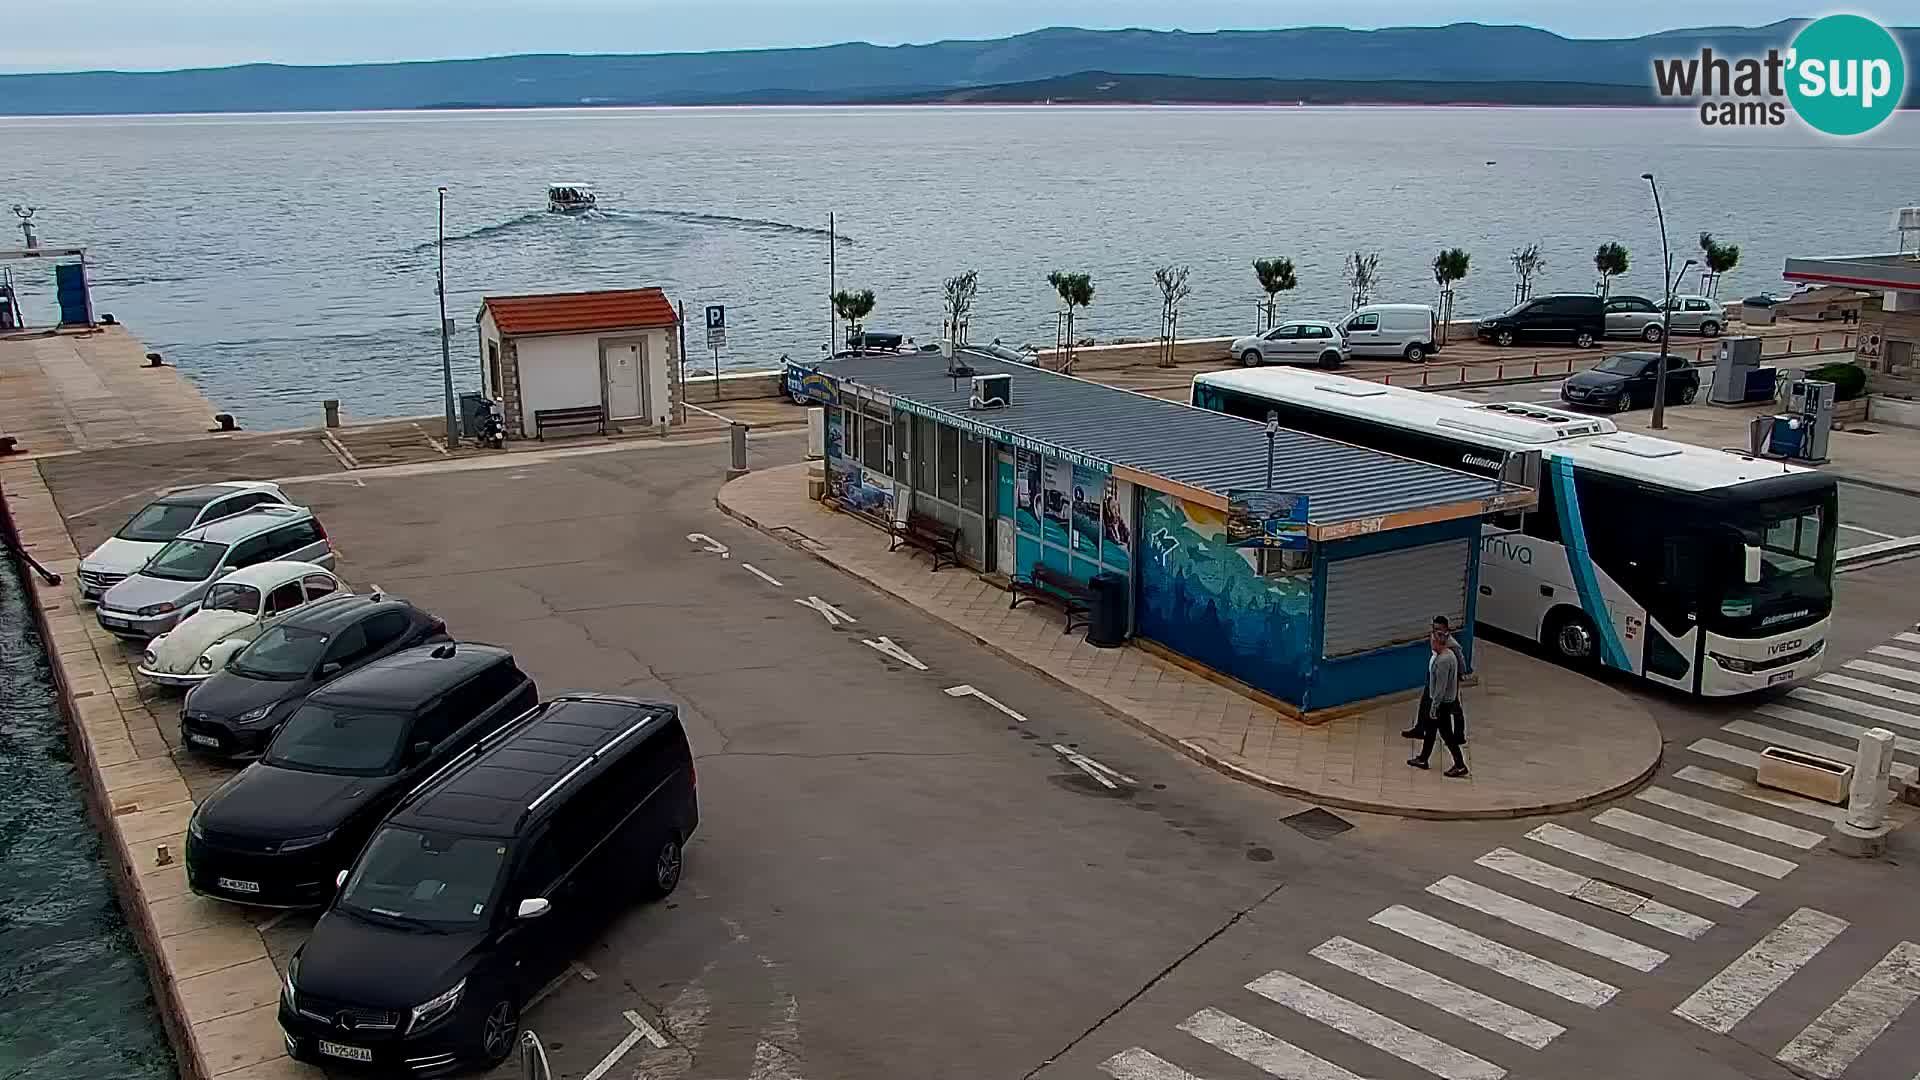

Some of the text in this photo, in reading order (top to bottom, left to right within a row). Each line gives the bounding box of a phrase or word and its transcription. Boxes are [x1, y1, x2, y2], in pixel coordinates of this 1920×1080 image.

[710, 308, 721, 326] P
[1011, 435, 1025, 448] BUS
[1027, 440, 1056, 456] STATION
[1058, 449, 1082, 466] TICKET
[1083, 458, 1109, 473] OFFICE
[1767, 639, 1802, 656] IVECO
